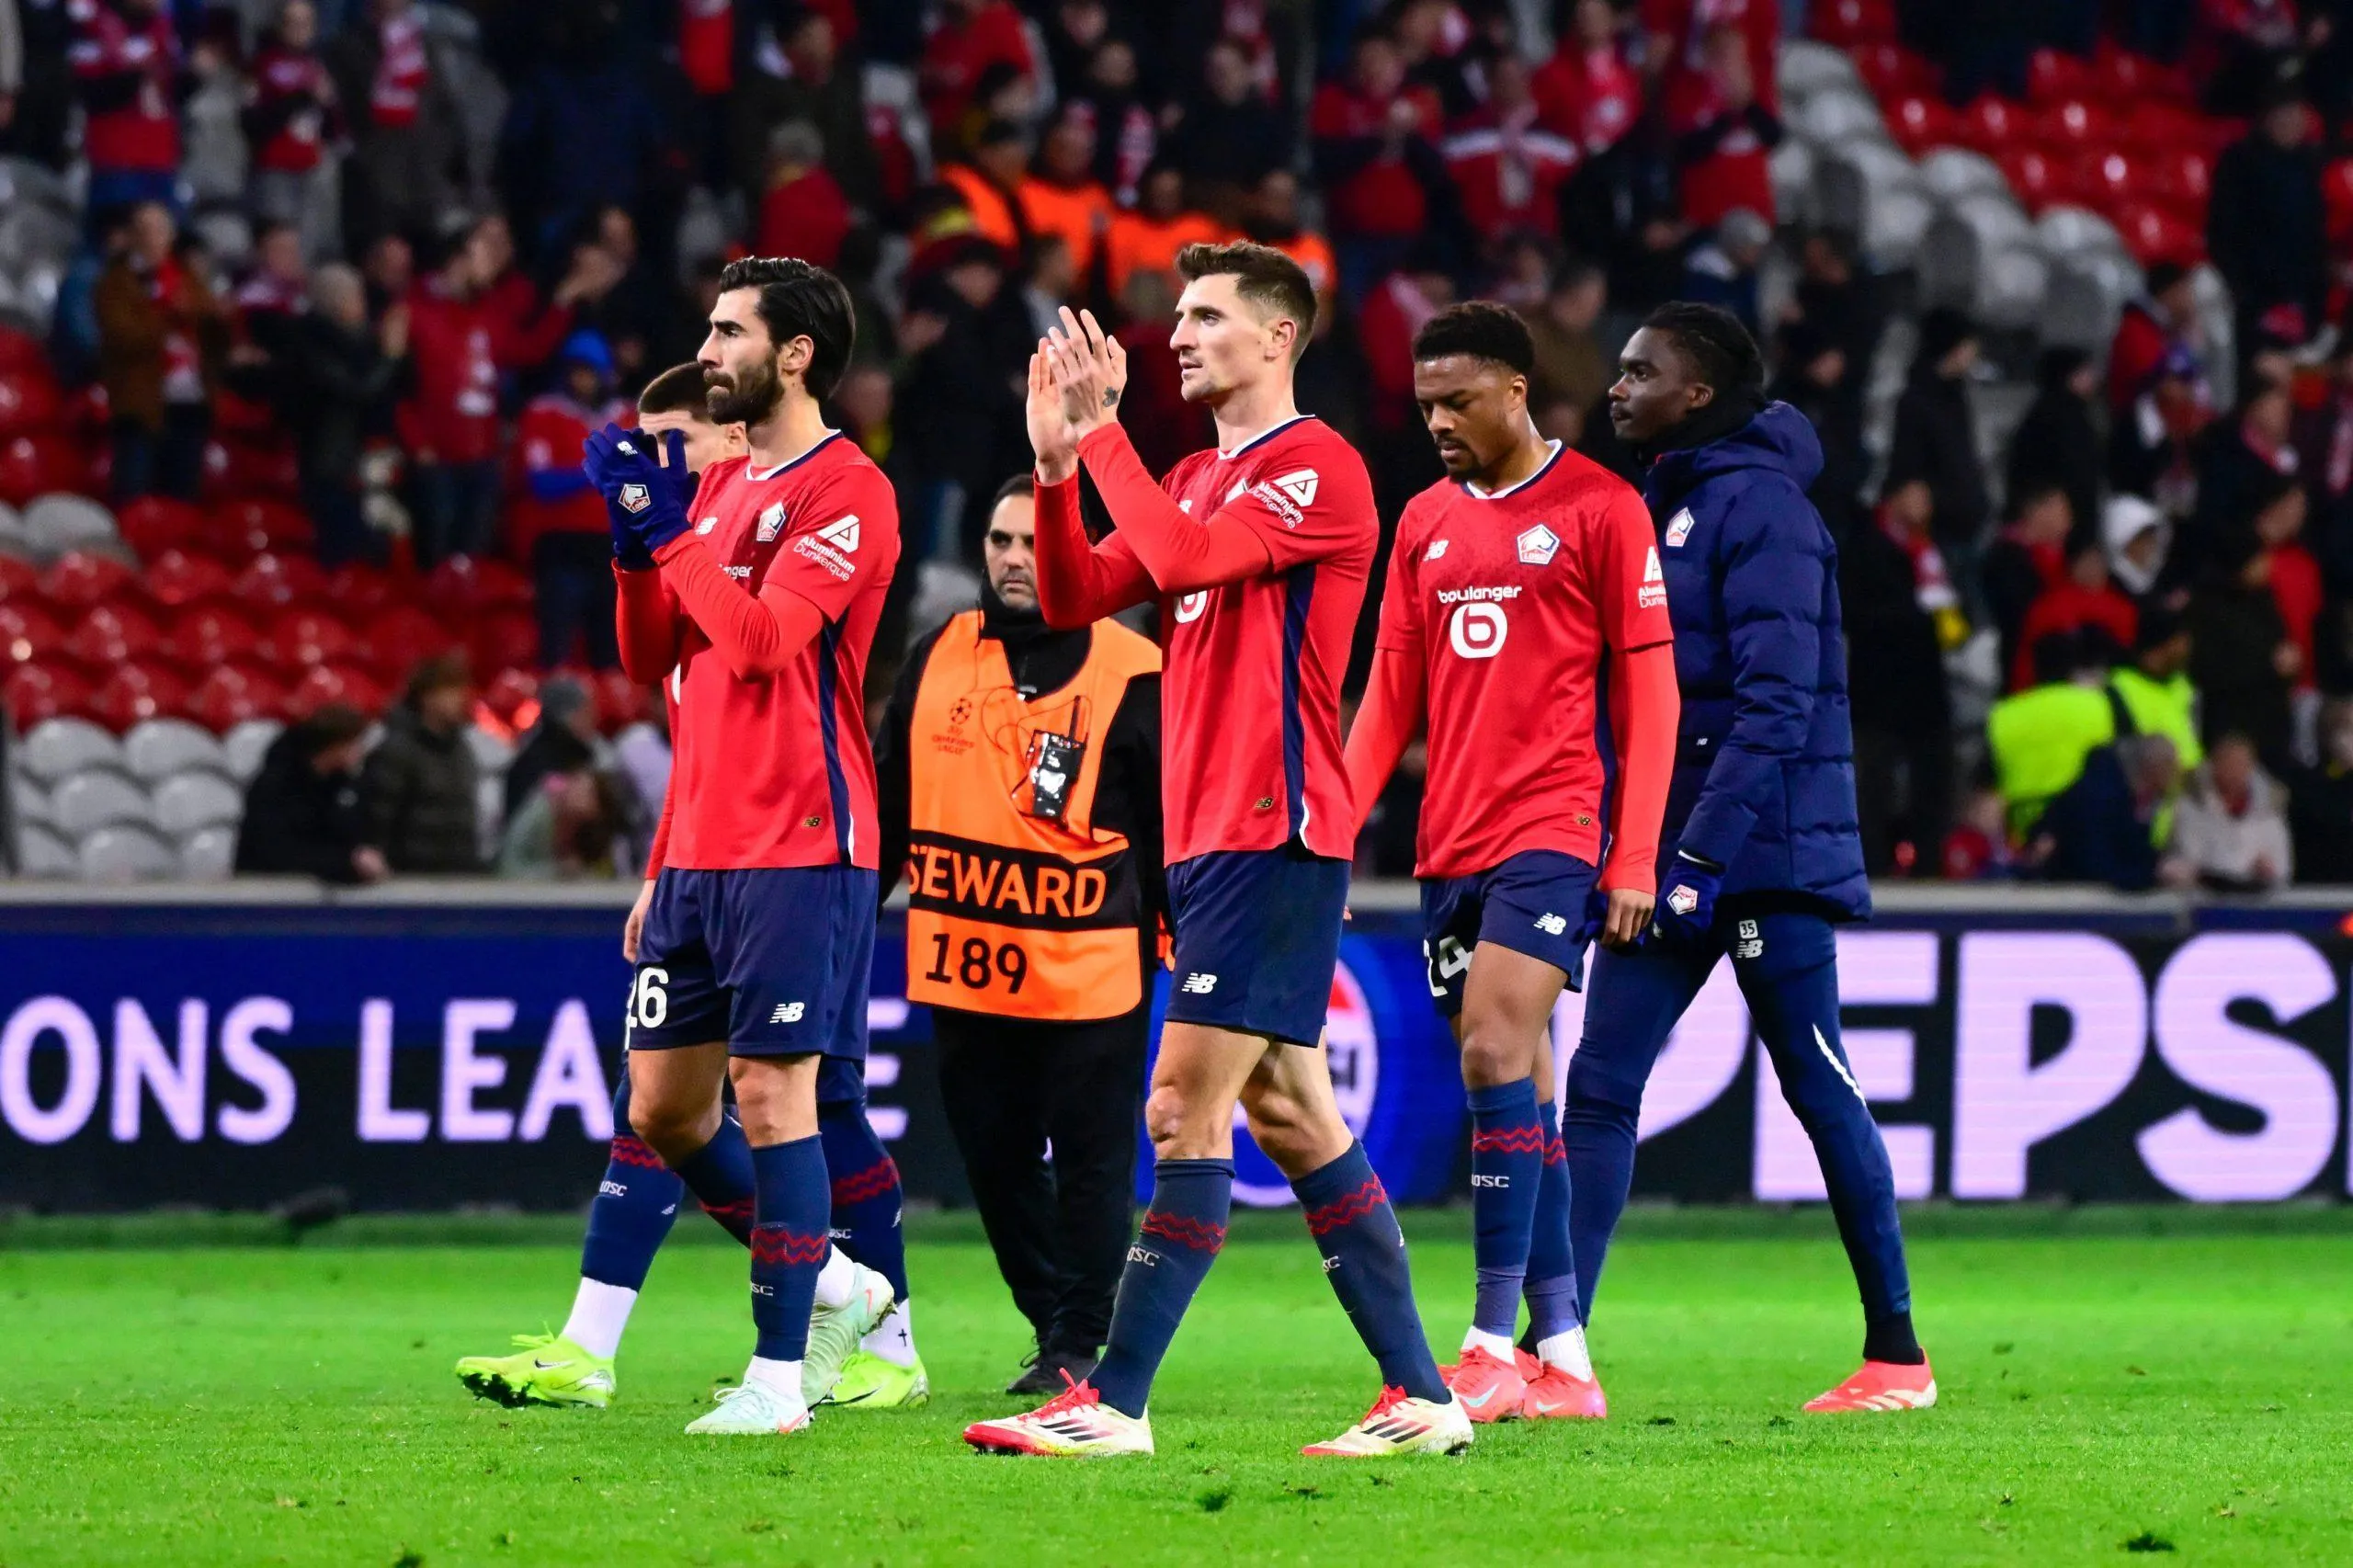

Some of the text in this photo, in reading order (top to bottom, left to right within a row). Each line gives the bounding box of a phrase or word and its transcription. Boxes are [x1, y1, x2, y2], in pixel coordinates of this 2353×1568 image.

[793, 543, 850, 582] Dunkerque
[801, 536, 856, 574] Aluminium
[1438, 585, 1523, 604] boulanger
[926, 933, 1028, 994] 189
[0, 995, 297, 1144] ONS
[1553, 931, 2353, 1201] EPS
